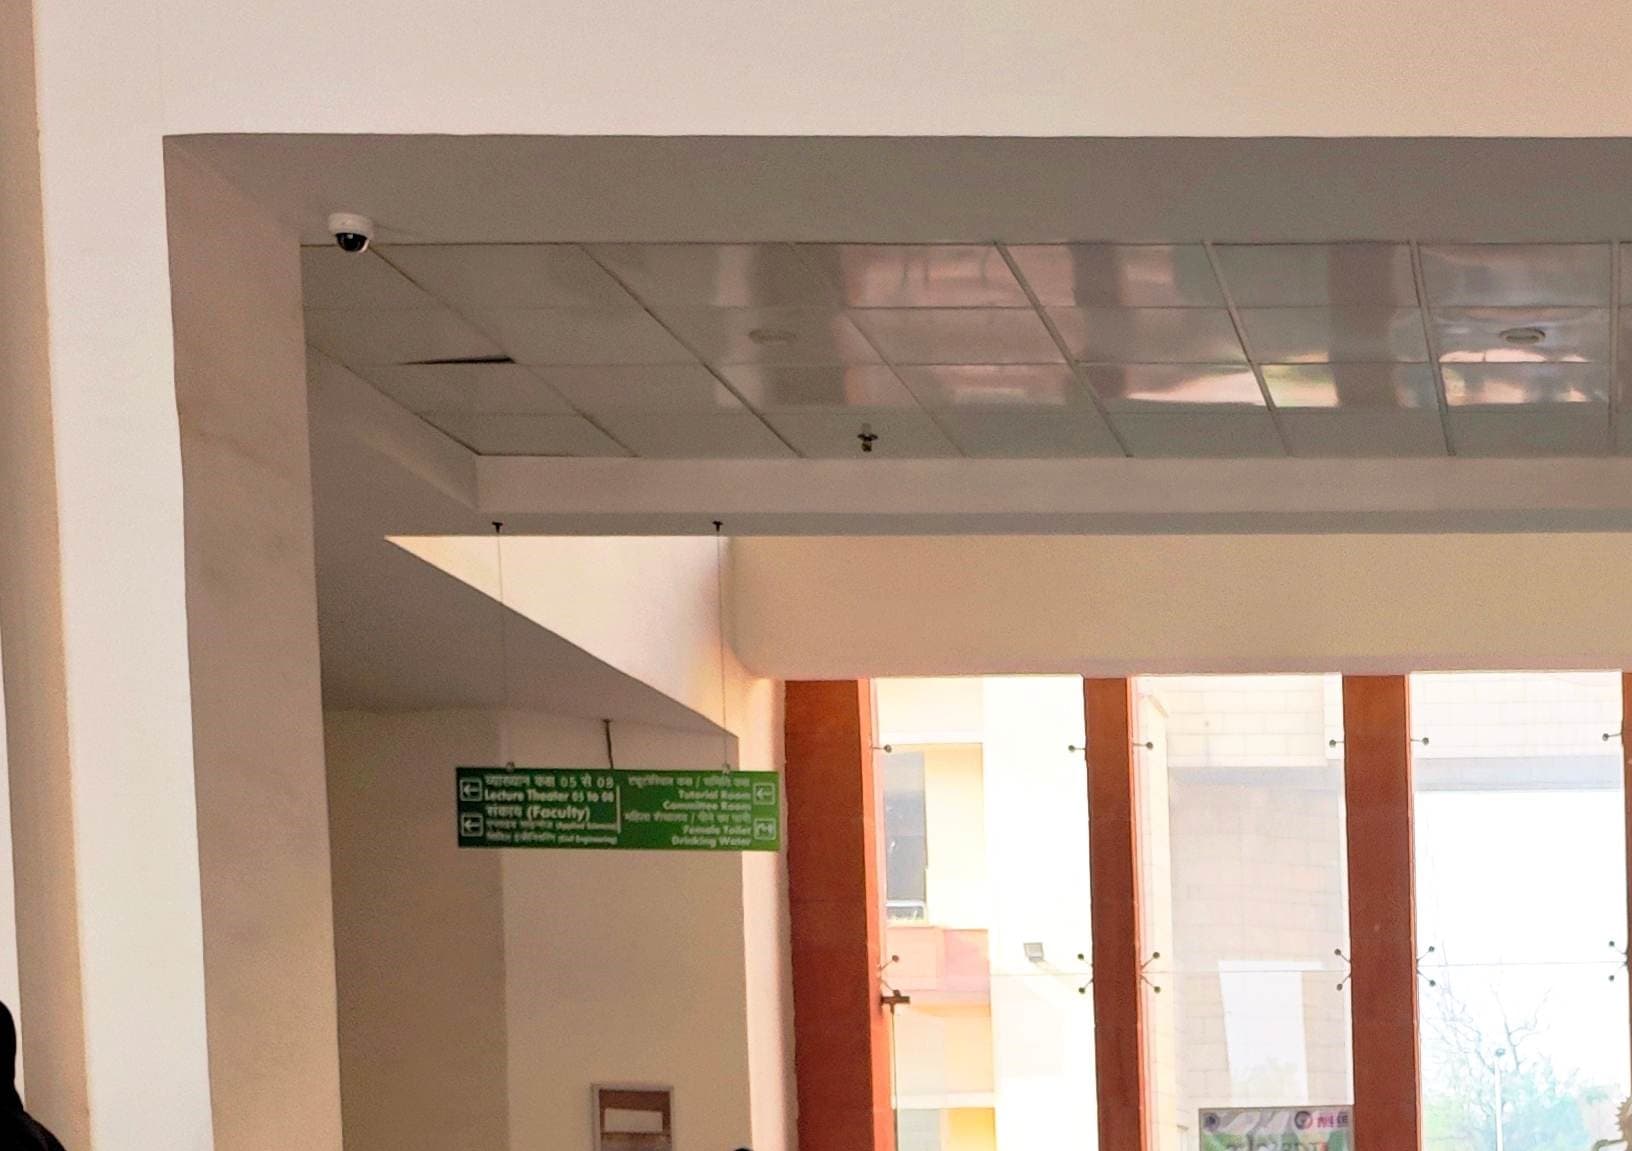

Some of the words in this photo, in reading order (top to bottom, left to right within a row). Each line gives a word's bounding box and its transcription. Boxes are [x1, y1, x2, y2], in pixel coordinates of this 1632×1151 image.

[560, 776, 578, 789] 05
[484, 788, 525, 802] Lecture
[527, 787, 569, 802] Theater
[526, 804, 591, 822] (Faculty)
[723, 824, 752, 836] Toilet
[671, 834, 717, 849] Drinking
[718, 835, 753, 847] Water
